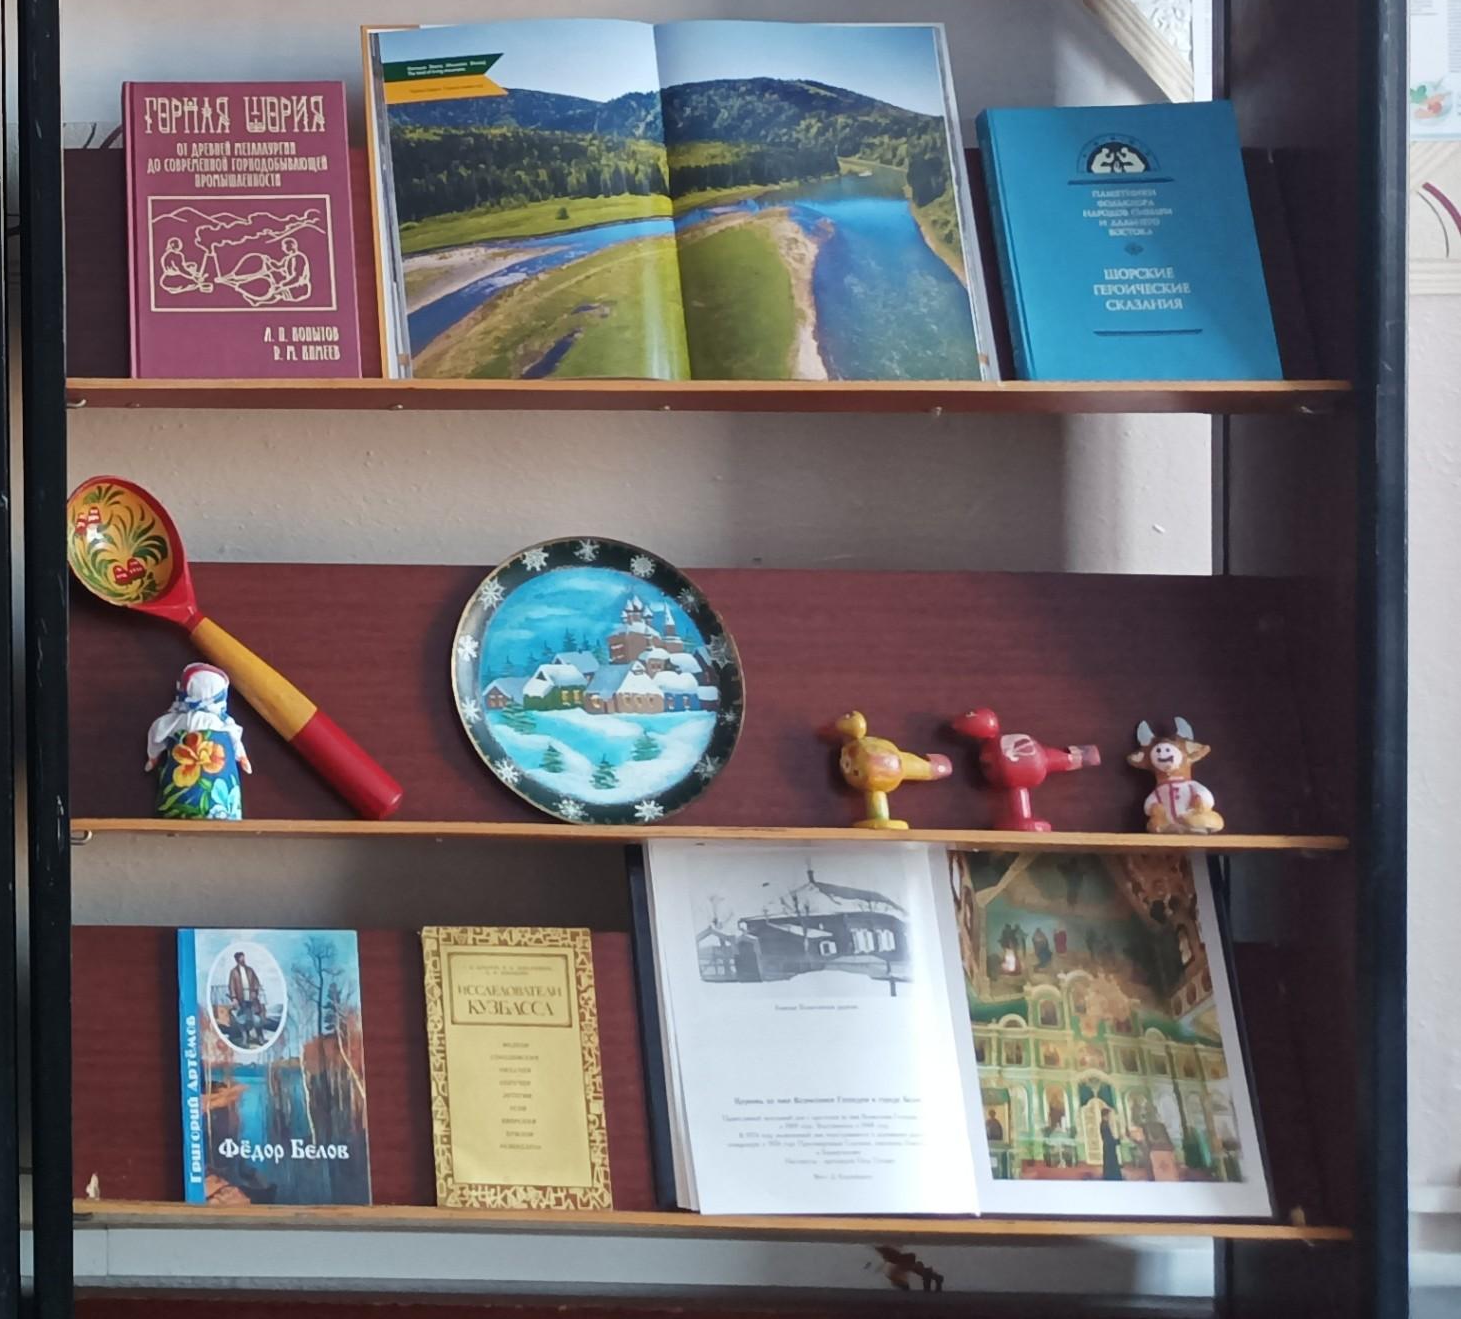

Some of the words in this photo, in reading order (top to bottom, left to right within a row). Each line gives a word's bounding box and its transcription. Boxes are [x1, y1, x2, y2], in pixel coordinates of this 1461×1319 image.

[144, 97, 231, 133] ГОРНАЯ
[243, 96, 326, 133] ШОРИЯ
[191, 141, 231, 157] ДРЕВНЕЙ
[234, 141, 296, 156] МЕТАЛЛУРГИИ
[147, 158, 161, 173] ДО
[164, 156, 228, 172] СОВРЕМЕННОЙ
[232, 155, 328, 172] ГОРНОДОБЫВАЮЩЕЙ
[1104, 267, 1174, 281] ШОРСКИЕ
[1093, 283, 1190, 296] ГЕРОИЧЕСКИЕ
[1105, 298, 1183, 311] СКАЗАНИЯ
[458, 985, 562, 997] ИССЛЕДОВАТЕЛИ
[468, 1000, 554, 1016] КУЗБАССА
[218, 1138, 284, 1163] Фёдор
[291, 1138, 350, 1160] Белов
